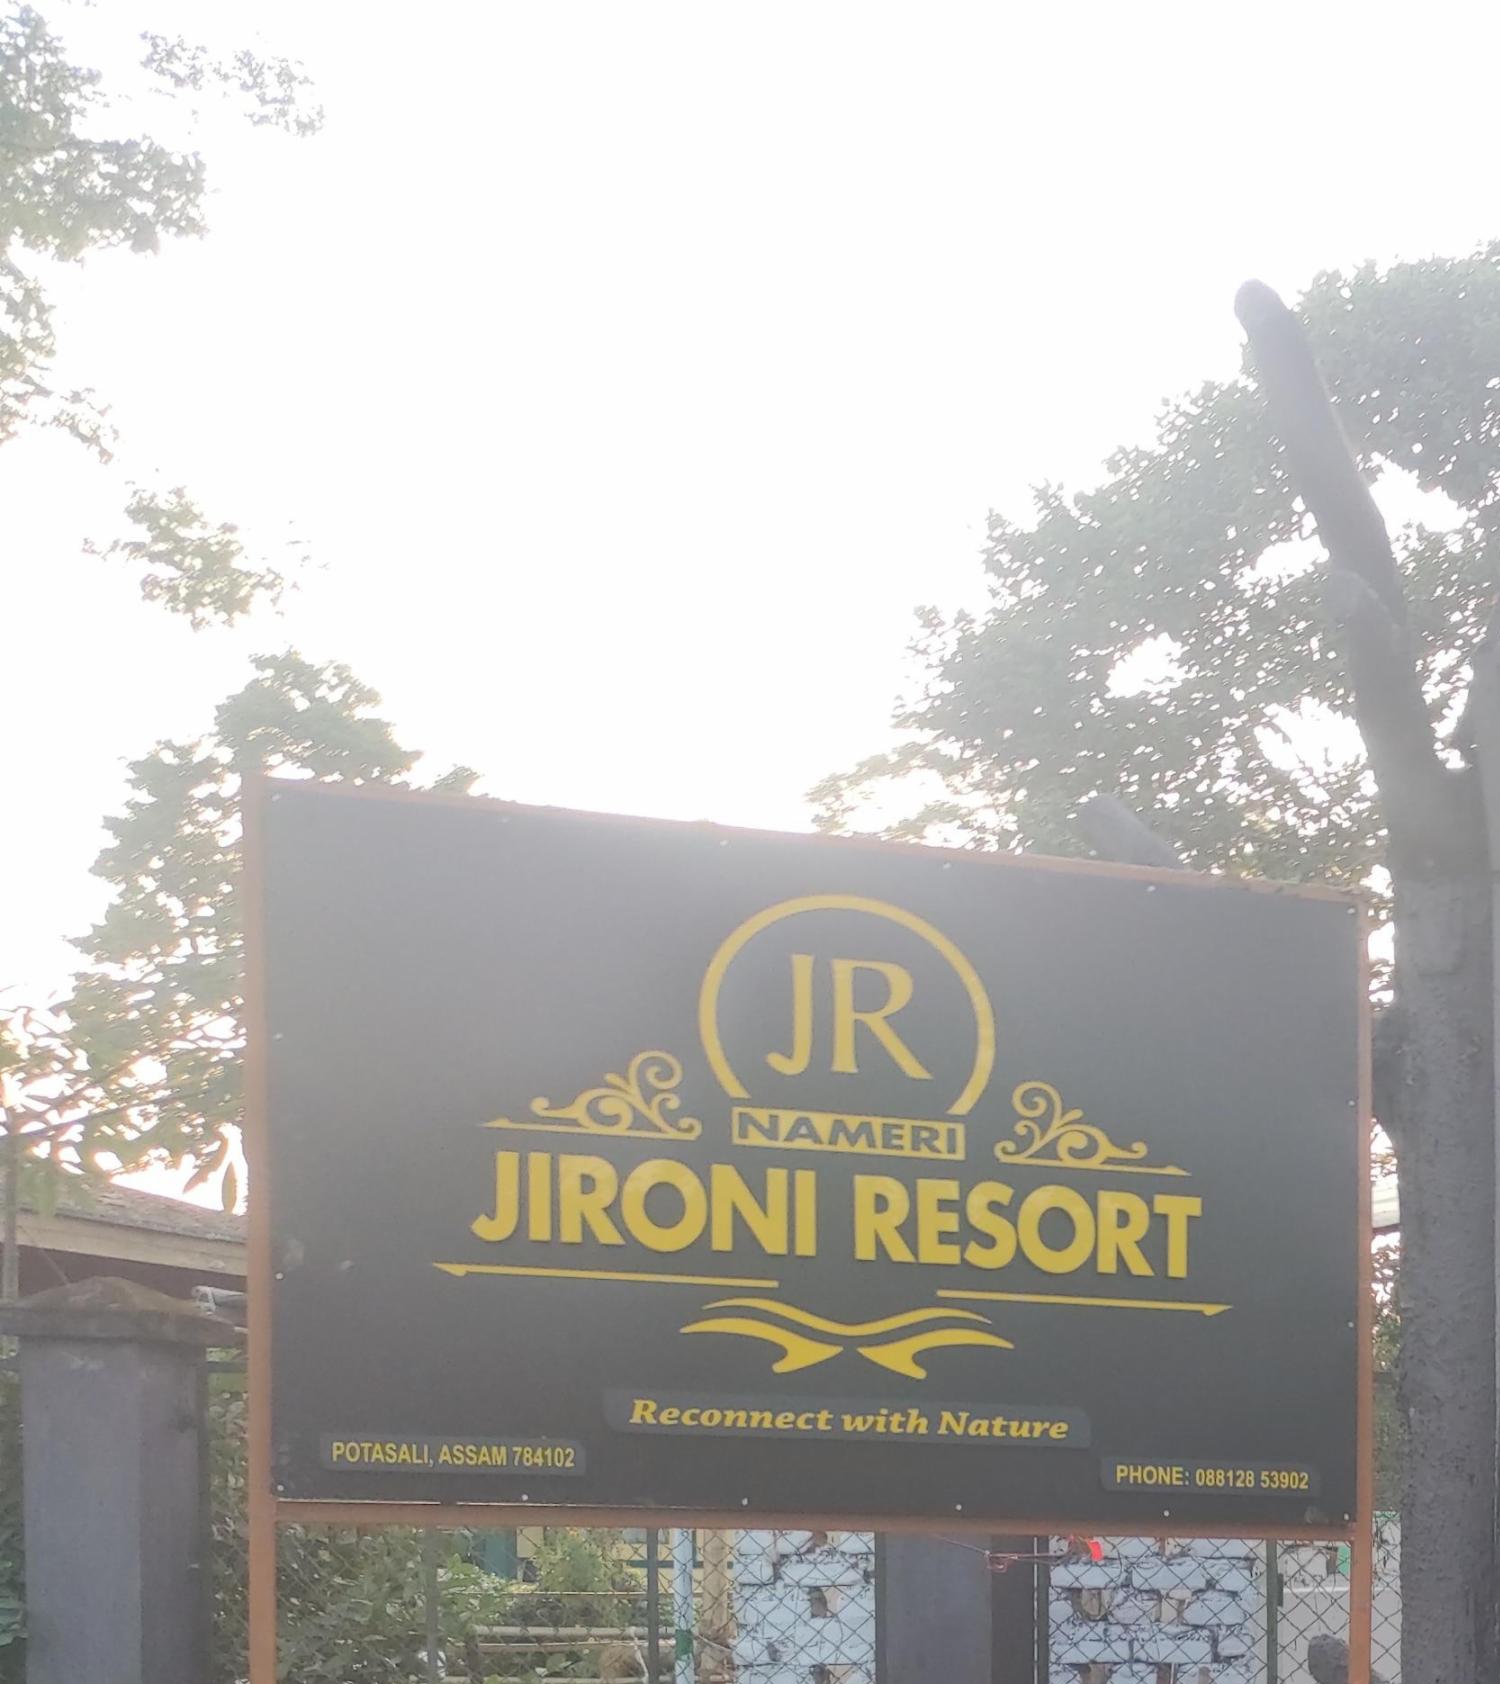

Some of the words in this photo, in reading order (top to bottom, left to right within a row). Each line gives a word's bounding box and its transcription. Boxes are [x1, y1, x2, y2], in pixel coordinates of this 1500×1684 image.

[766, 953, 933, 1080] JR
[736, 1110, 960, 1156] NAMERI
[470, 1151, 817, 1257] JIRONI
[854, 1174, 1202, 1279] RESORT
[629, 1399, 834, 1432] Reconnect
[841, 1408, 929, 1435] with
[937, 1411, 1070, 1440] Nature
[331, 1441, 434, 1468] POTASALI,
[438, 1444, 507, 1466] ASSAM
[512, 1446, 576, 1468] 784102
[1115, 1465, 1190, 1486] PHONE:
[1195, 1468, 1256, 1488] 088128
[1260, 1470, 1309, 1489] 53902
